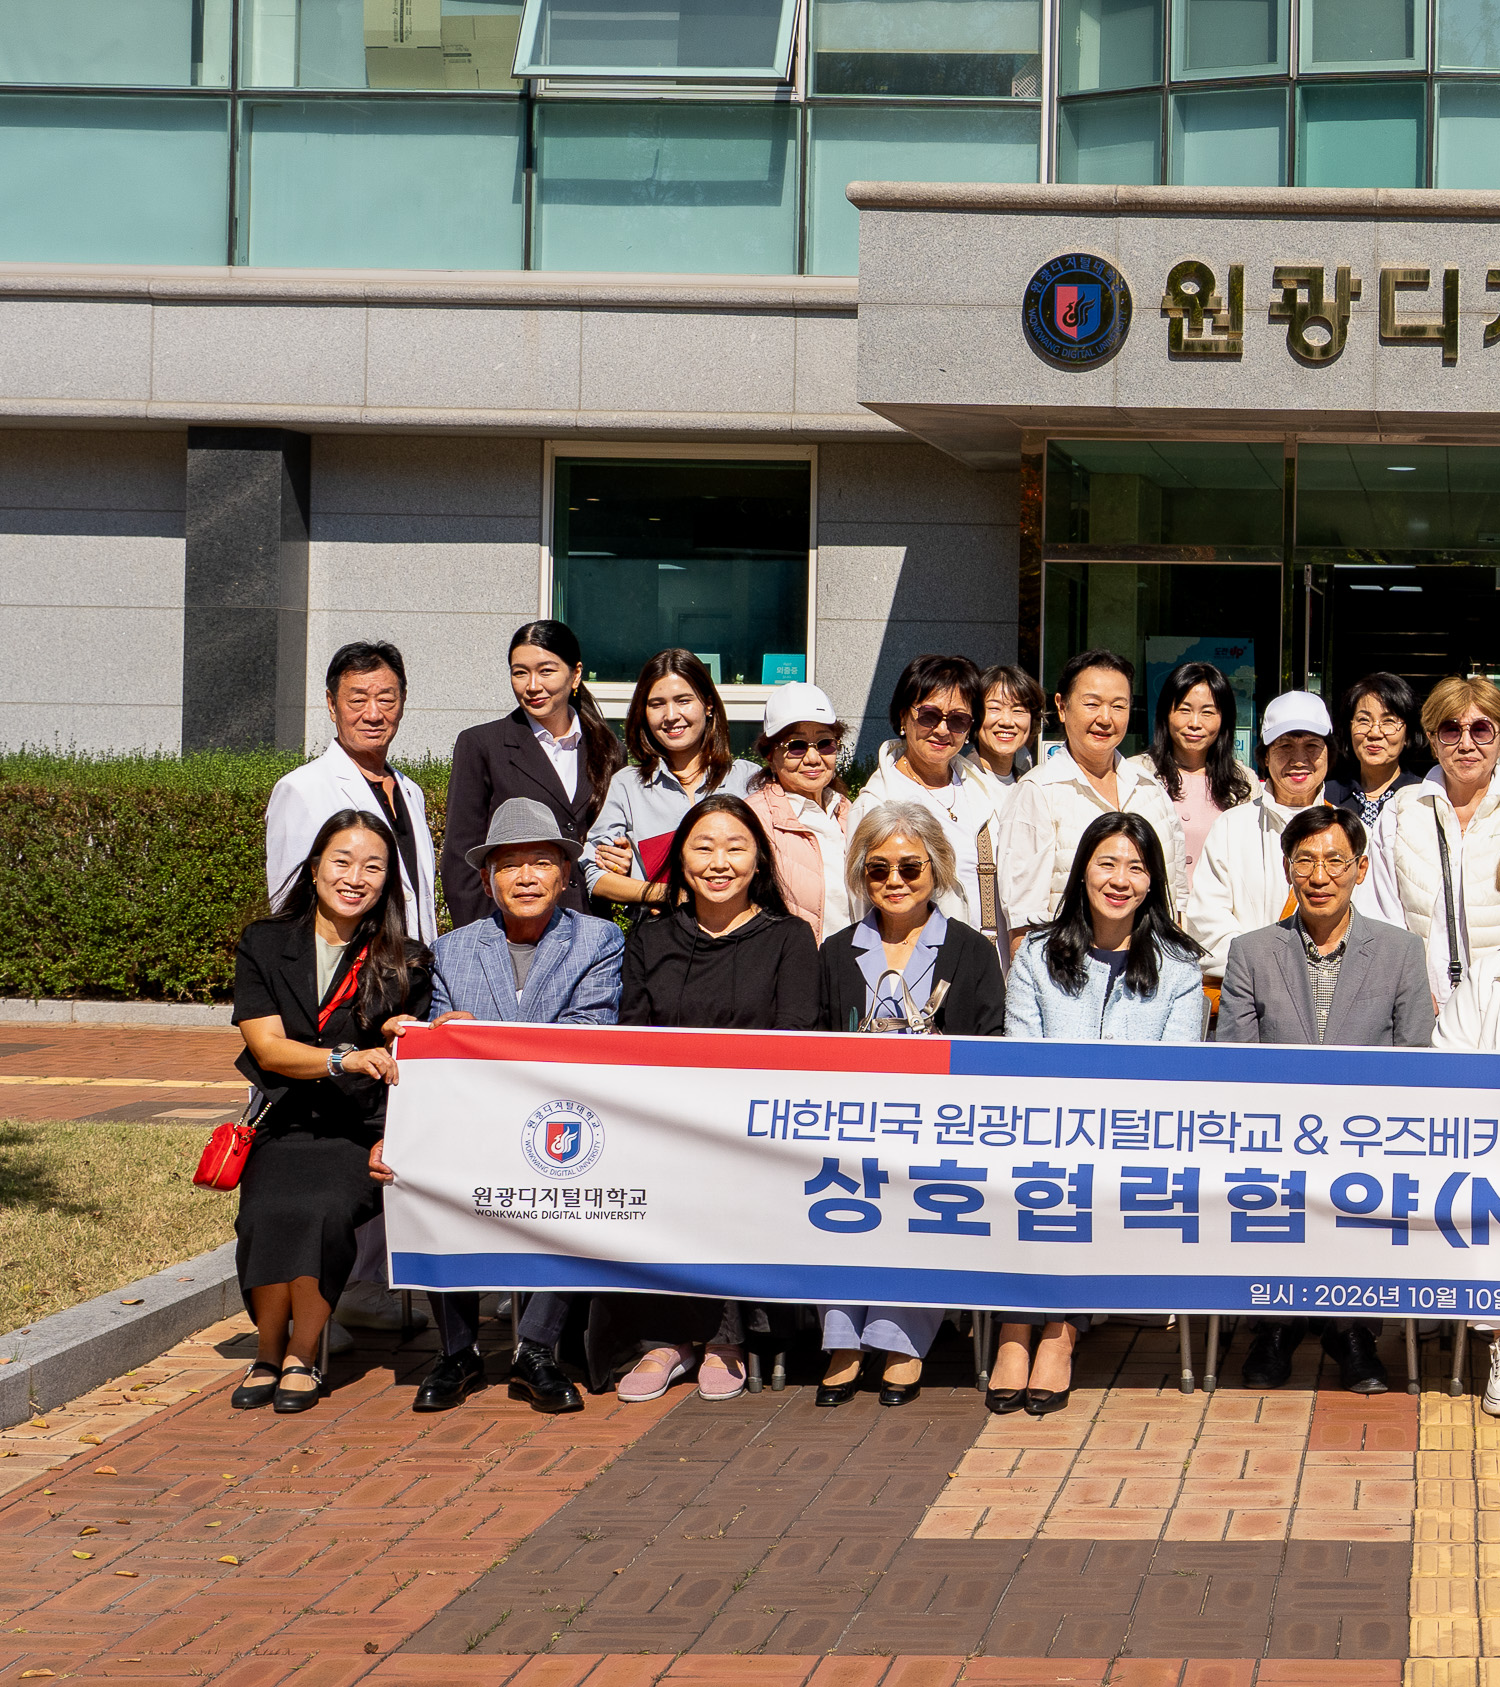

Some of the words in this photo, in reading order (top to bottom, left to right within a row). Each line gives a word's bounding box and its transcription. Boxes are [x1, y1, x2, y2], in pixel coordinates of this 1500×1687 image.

[1030, 256, 1126, 294] 원광디지털대학교
[1028, 308, 1060, 354] WONKWANG
[1061, 347, 1096, 359] DIGITAL
[527, 1101, 600, 1130] 원광디지털대학교
[747, 1099, 923, 1145] 대한민국
[933, 1103, 1283, 1153] 원광디지털대학교
[1293, 1114, 1328, 1155] &
[525, 1139, 549, 1173] WONKWANG
[549, 1168, 577, 1177] DIGITAL
[576, 1140, 601, 1172] UNIVERSITY
[471, 1186, 648, 1208] 원광디지털대학교
[474, 1208, 538, 1220] WONKWANG
[541, 1210, 582, 1220] DIGITAL
[585, 1211, 647, 1220] UNIVERSITY
[1250, 1283, 1294, 1305] 일시
[1314, 1285, 1400, 1307] 2026년
[1408, 1286, 1457, 1309] 10월
